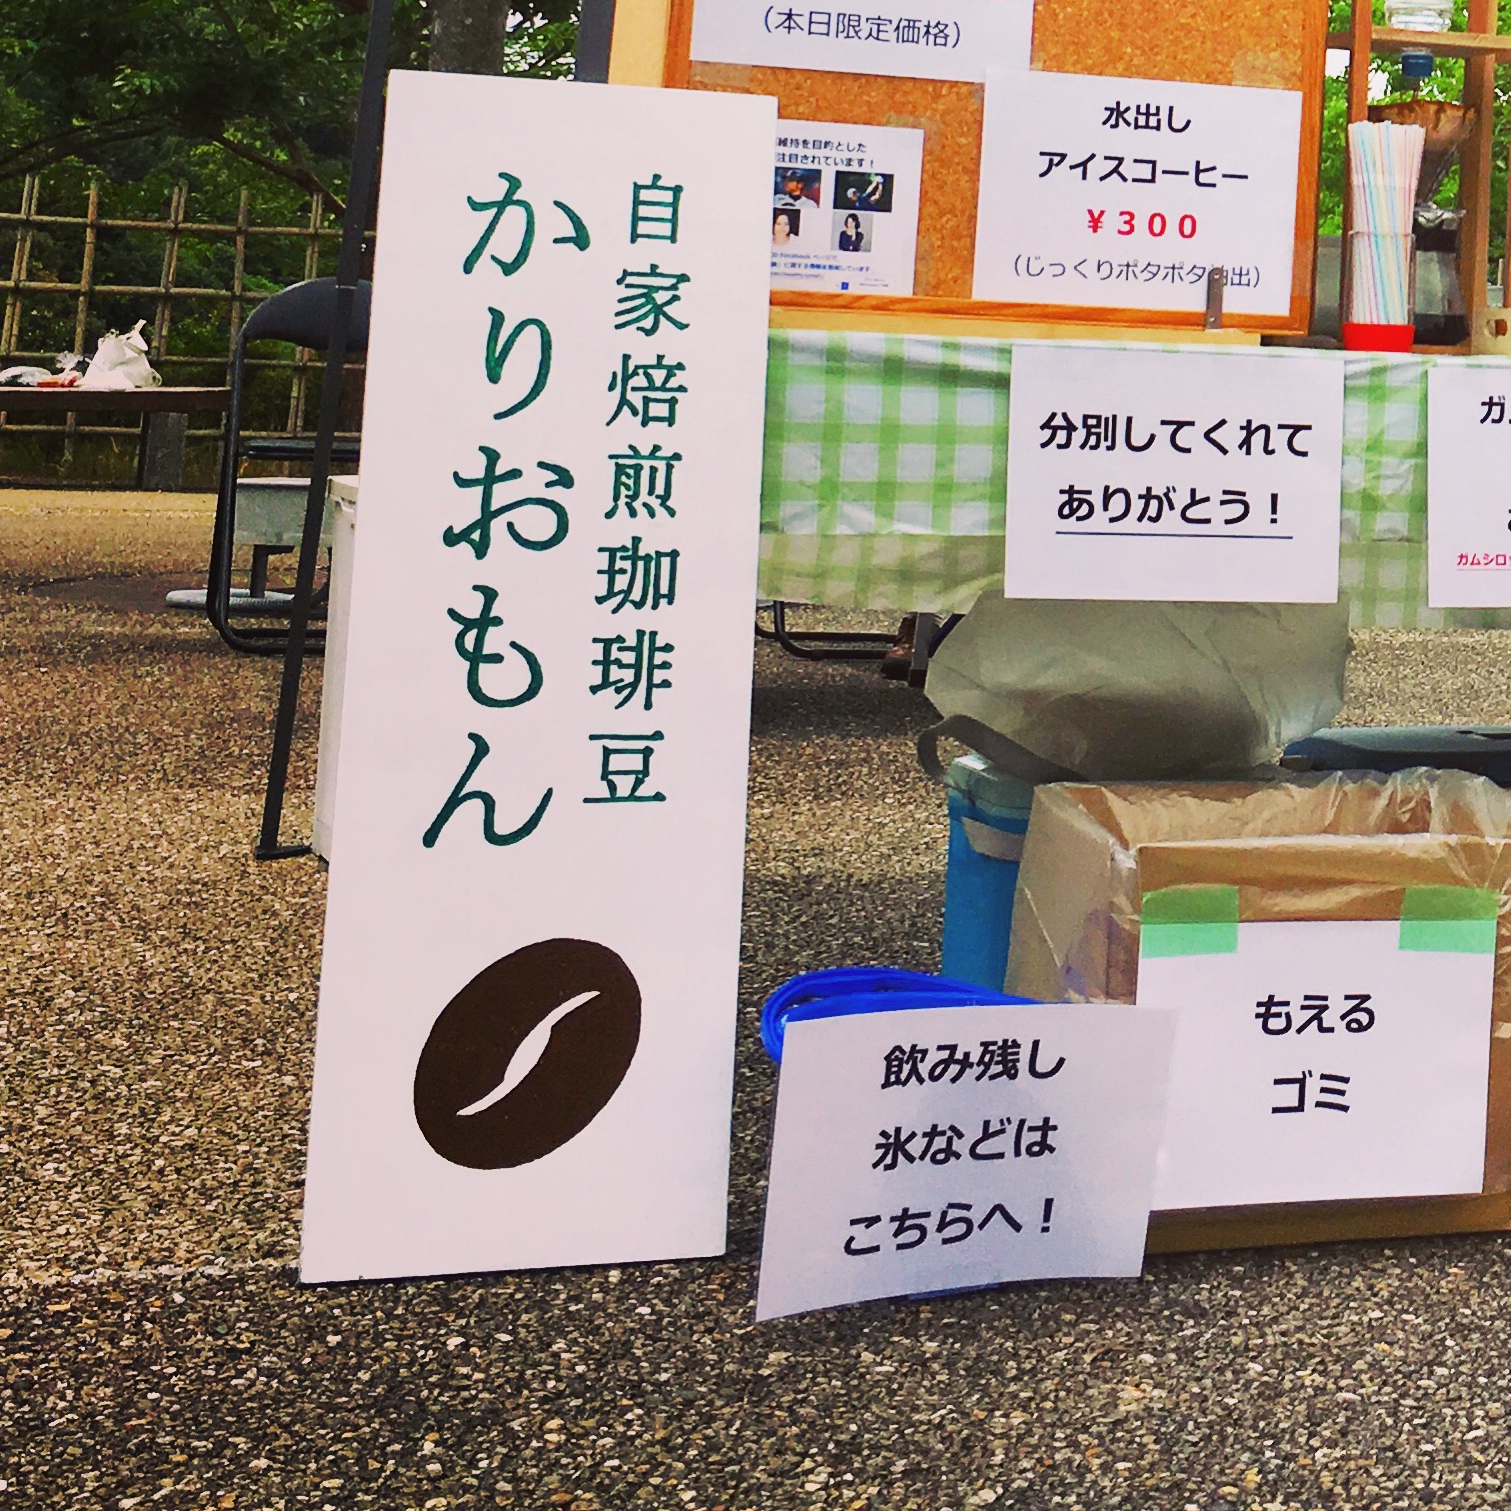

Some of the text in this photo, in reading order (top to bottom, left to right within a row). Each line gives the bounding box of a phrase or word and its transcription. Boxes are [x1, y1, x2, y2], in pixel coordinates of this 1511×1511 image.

[764, 5, 961, 49] （本日限定価格）
[1101, 100, 1192, 134] 水出し
[1038, 150, 1249, 189] アイスコーヒー
[1086, 208, 1197, 239] ¥300
[1014, 253, 1260, 288] （じっくりポタポタ出）
[1039, 411, 1313, 458] 分別してくれて
[421, 171, 591, 849] かりおもん
[583, 173, 691, 804] 自家焙煎珈琲豆
[1057, 484, 1279, 526] ありがとう！
[1254, 993, 1376, 1036] もえる
[880, 1038, 1067, 1091] 飲み残し
[1271, 1069, 1351, 1115] ゴミ
[871, 1116, 1059, 1172] 氷などは
[843, 1197, 1055, 1257] こちらへ！
